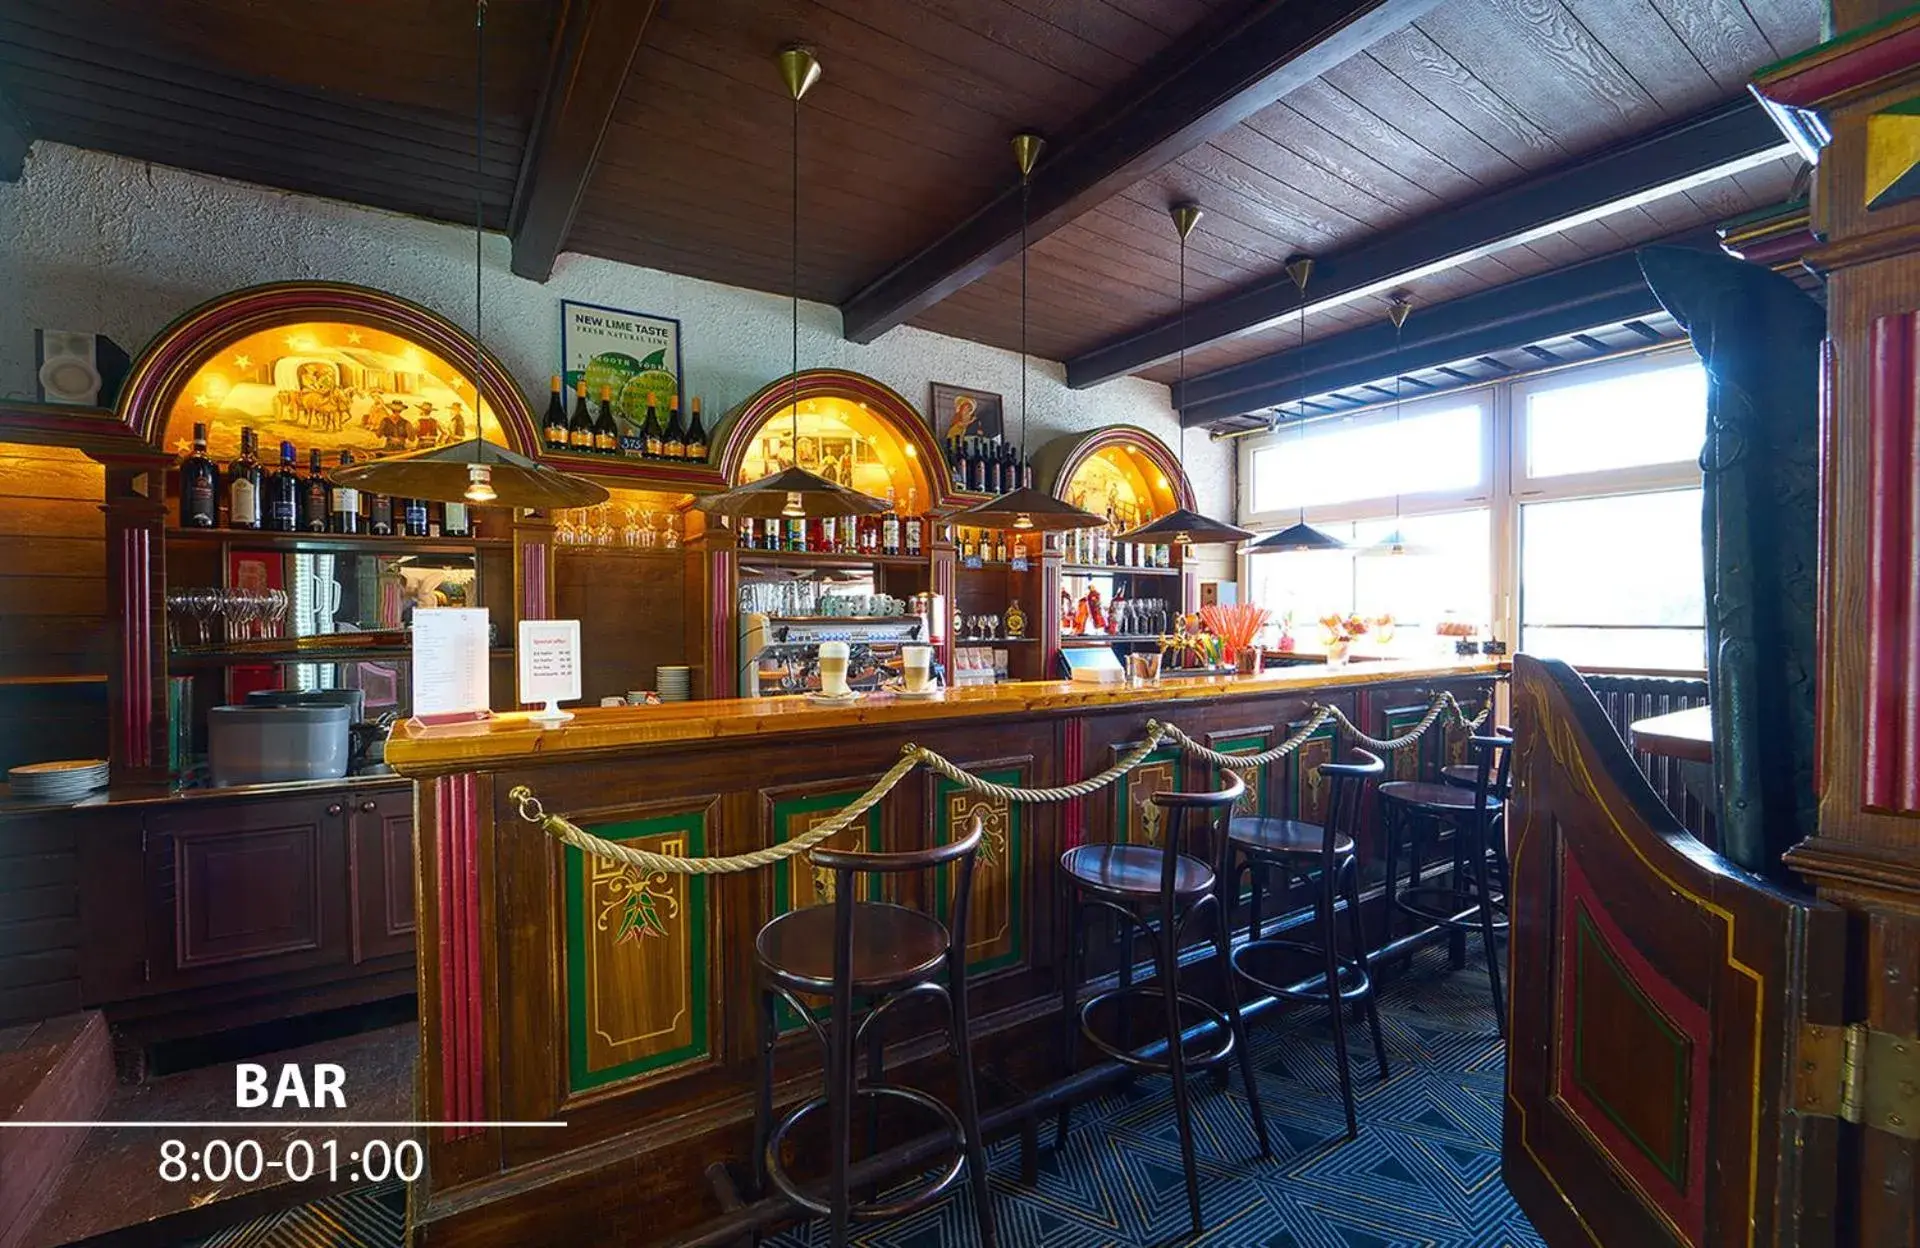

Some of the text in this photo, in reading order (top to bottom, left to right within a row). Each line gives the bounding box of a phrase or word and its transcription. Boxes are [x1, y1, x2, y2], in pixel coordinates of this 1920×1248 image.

[575, 314, 669, 338] NEW LIME TASTE
[576, 326, 668, 346] FRESH NATURAL LIME
